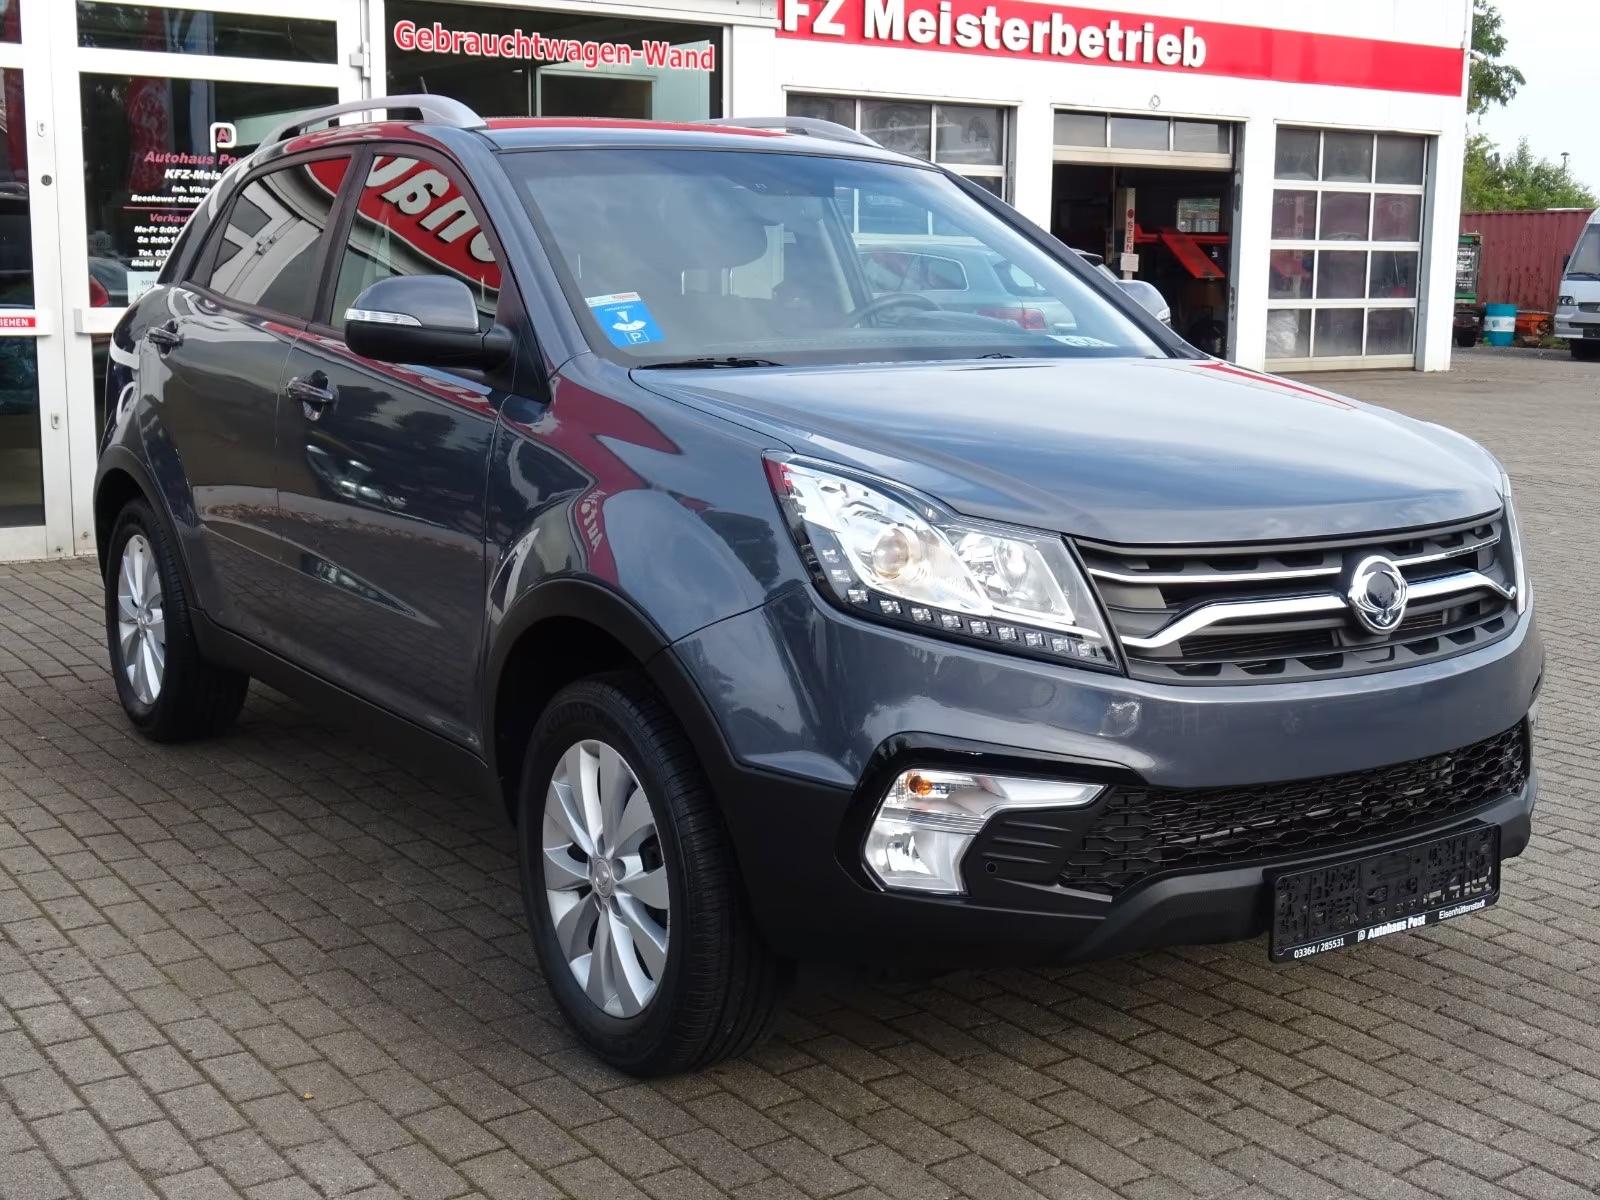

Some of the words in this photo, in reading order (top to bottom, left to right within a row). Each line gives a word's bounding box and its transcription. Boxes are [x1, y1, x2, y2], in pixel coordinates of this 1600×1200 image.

[863, 0, 1207, 68] Meisterbetrieb
[393, 19, 716, 72] Gebrauchtwagen-Wand
[144, 150, 215, 165] Autohaus
[137, 236, 149, 244] Sa
[138, 249, 153, 257] Tel.
[1367, 920, 1407, 940] Autohaus
[1408, 914, 1426, 929] Post
[1294, 945, 1316, 959] 03364
[1320, 937, 1345, 952] 285531
